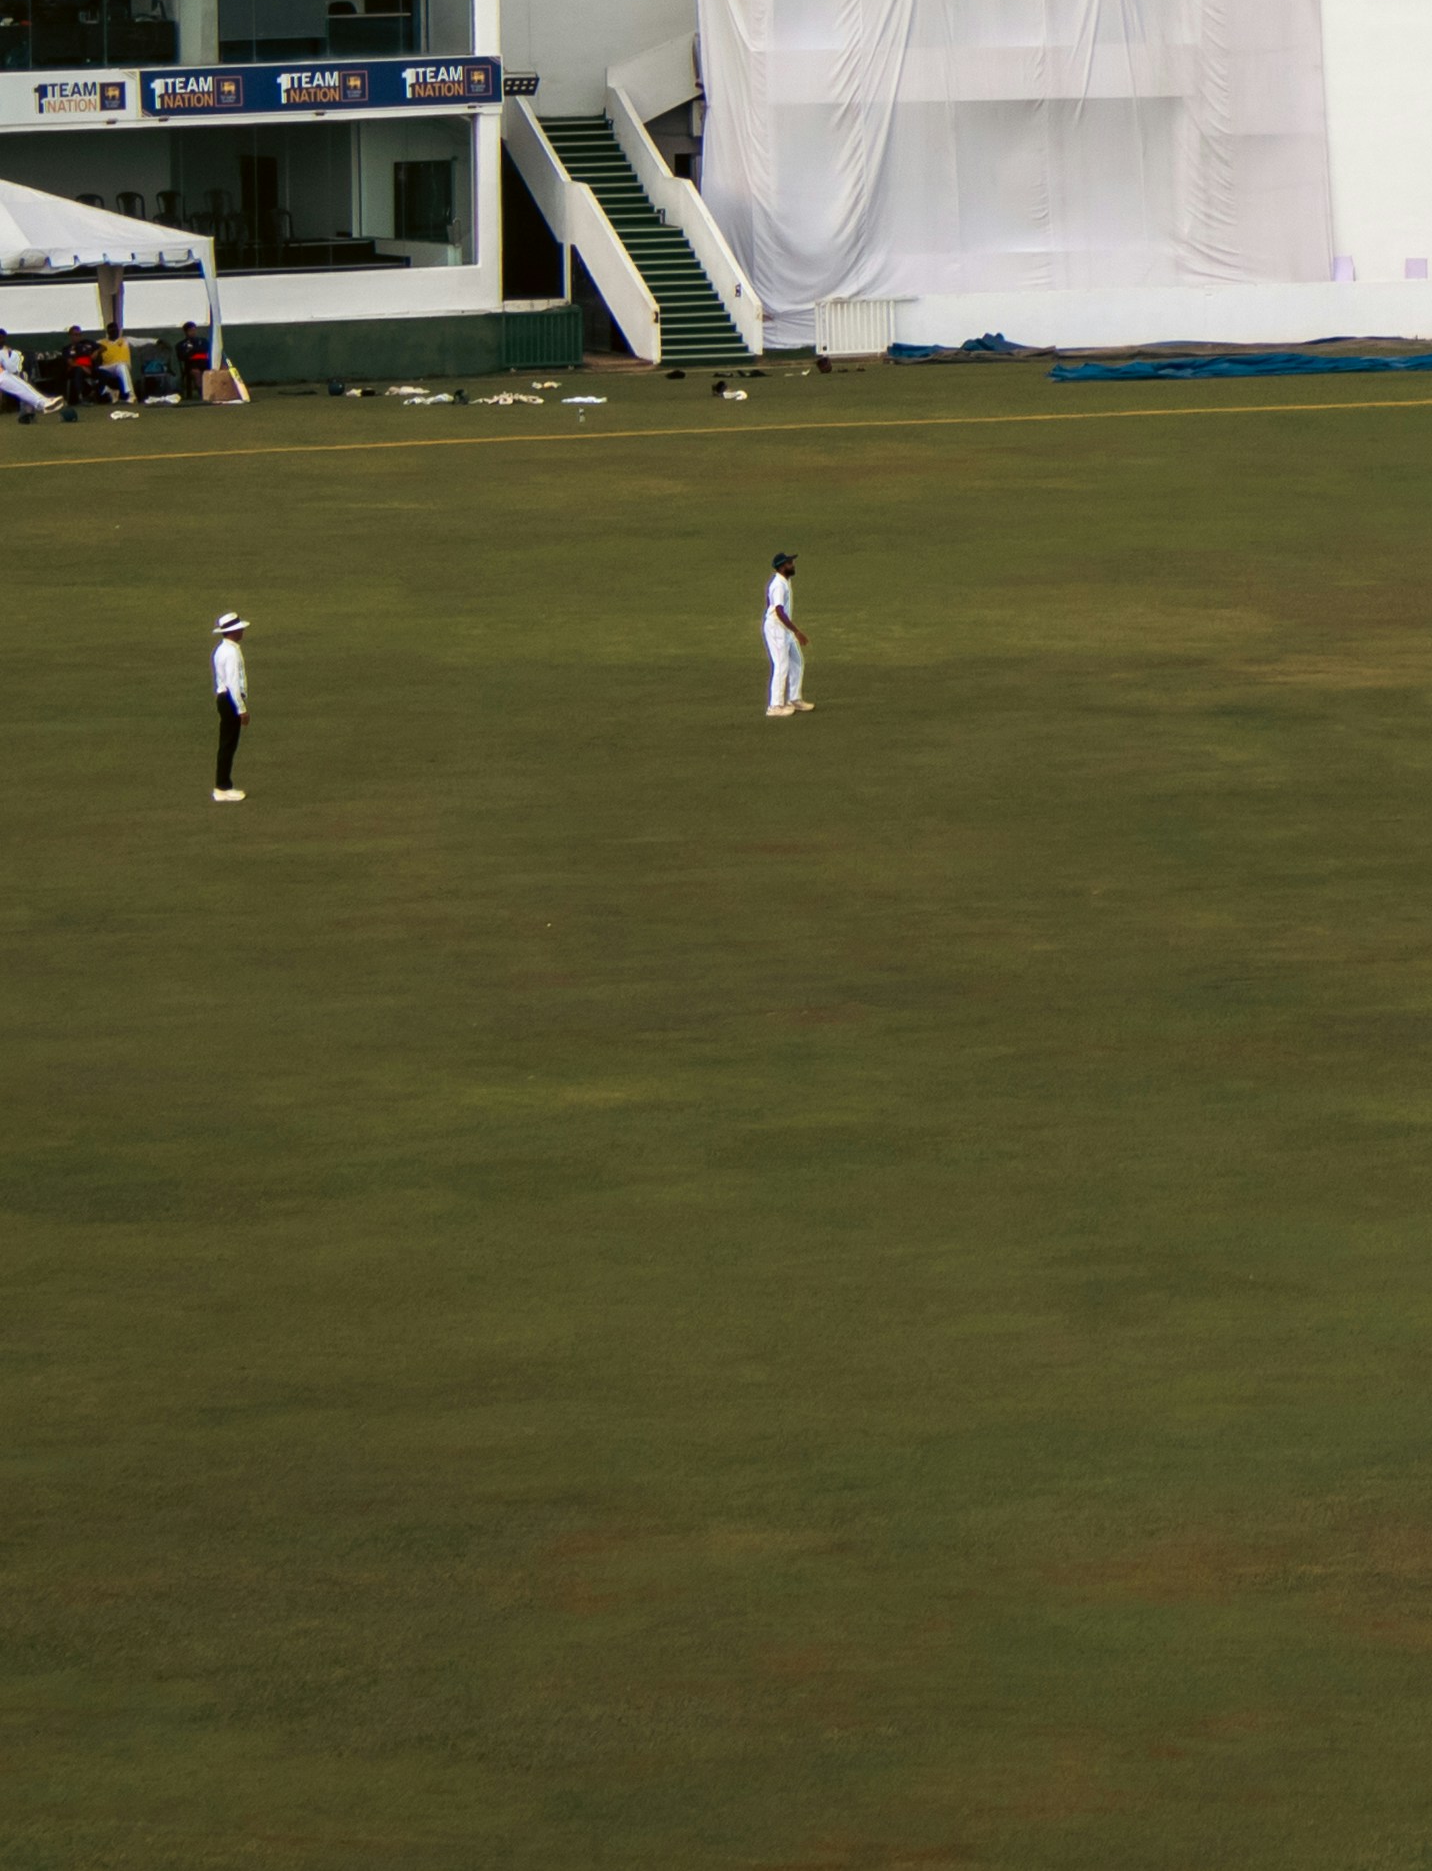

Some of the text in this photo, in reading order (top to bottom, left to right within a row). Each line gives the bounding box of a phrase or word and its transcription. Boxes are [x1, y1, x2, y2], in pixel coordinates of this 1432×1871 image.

[290, 88, 339, 104] NATION
[415, 83, 463, 99] NATION
[47, 98, 97, 113] NATION
[164, 93, 213, 109] NATION
